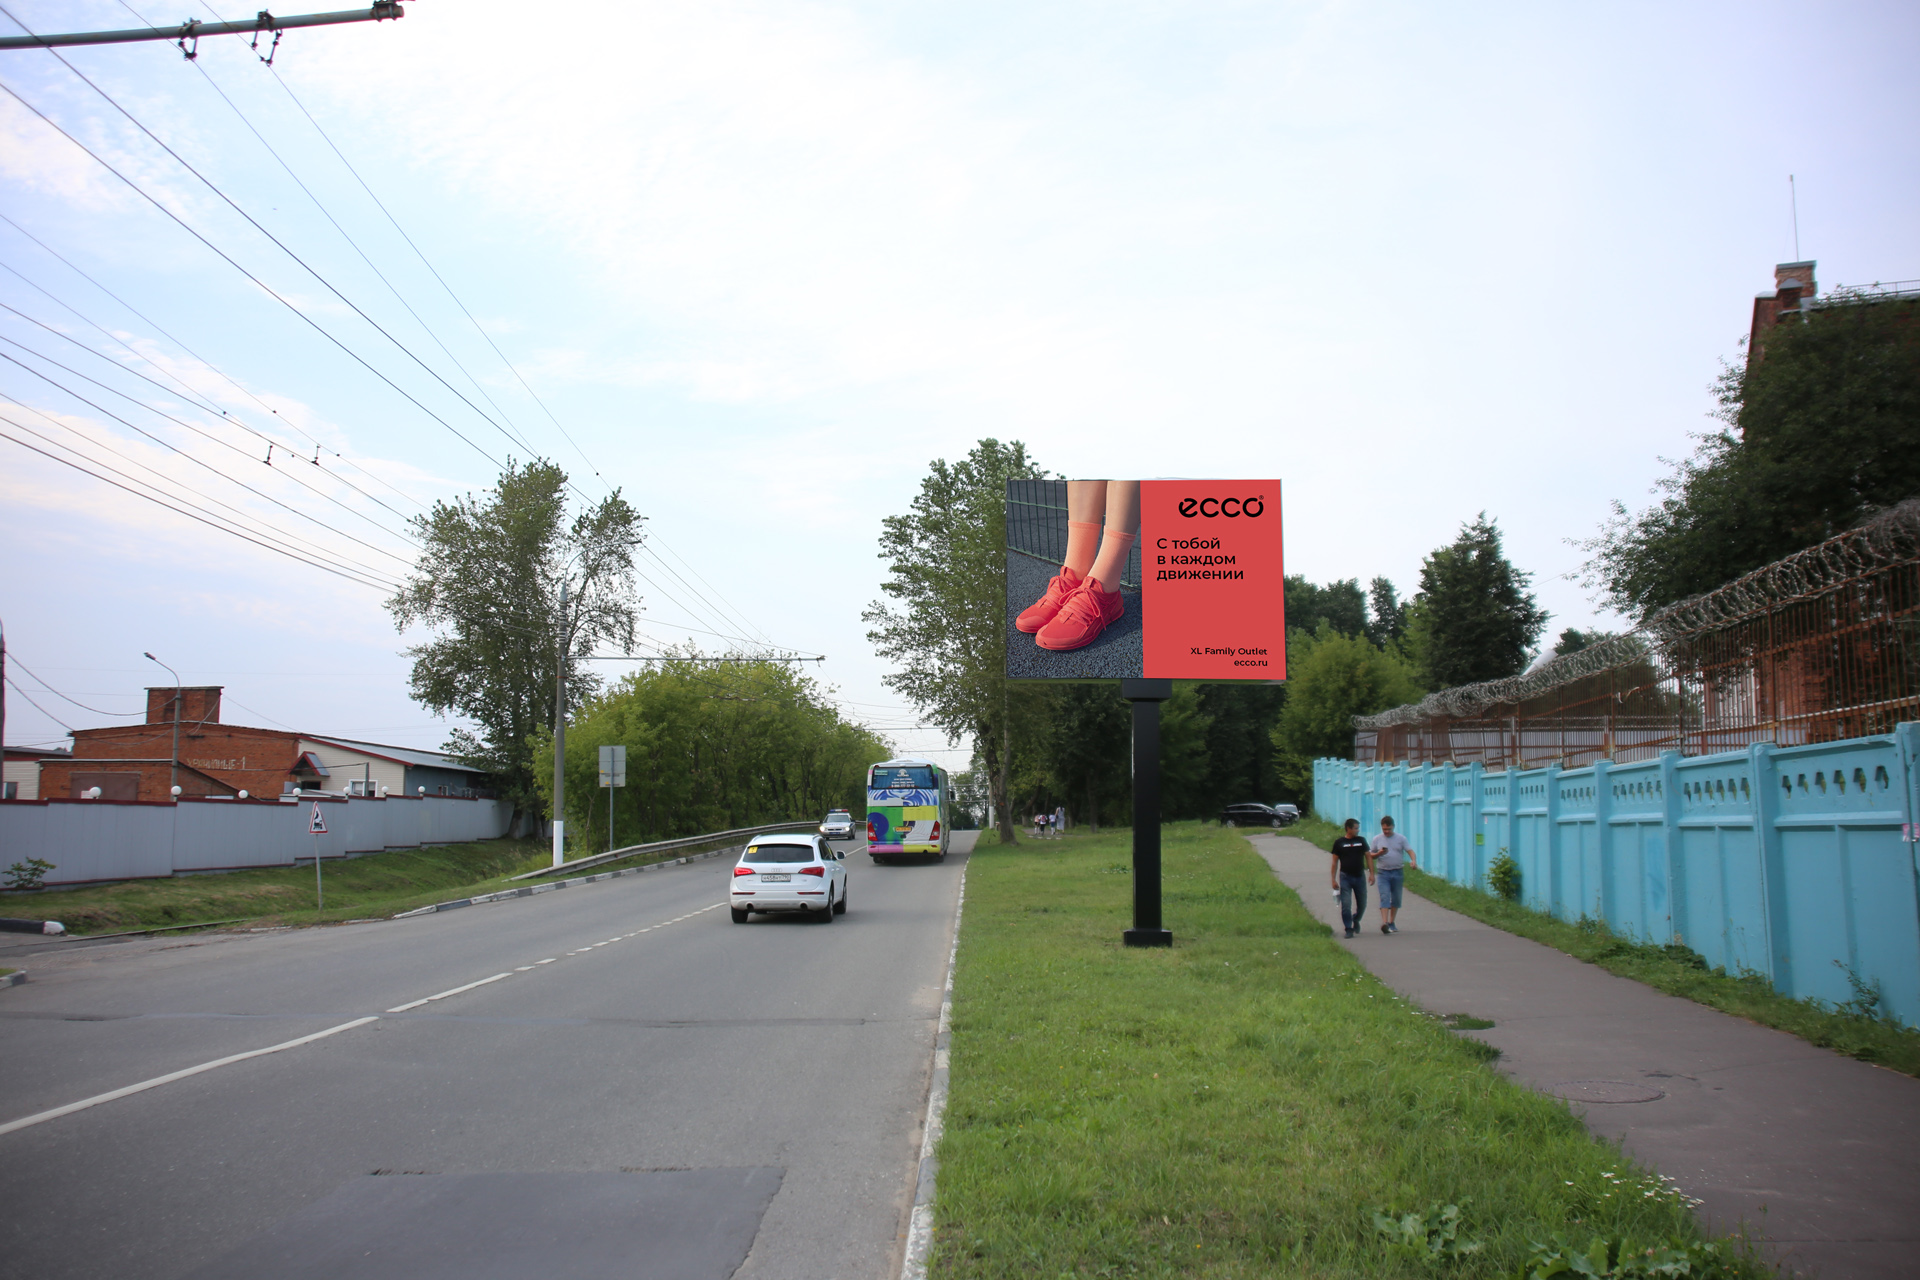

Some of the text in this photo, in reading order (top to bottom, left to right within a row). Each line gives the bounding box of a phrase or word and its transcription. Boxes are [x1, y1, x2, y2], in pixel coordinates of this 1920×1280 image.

[1157, 537, 1220, 549] С тобой
[1157, 555, 1236, 567] в каждом
[1157, 569, 1244, 581] движении
[1190, 647, 1268, 657] XL Family Outlet
[1234, 659, 1268, 667] ecco.ru
